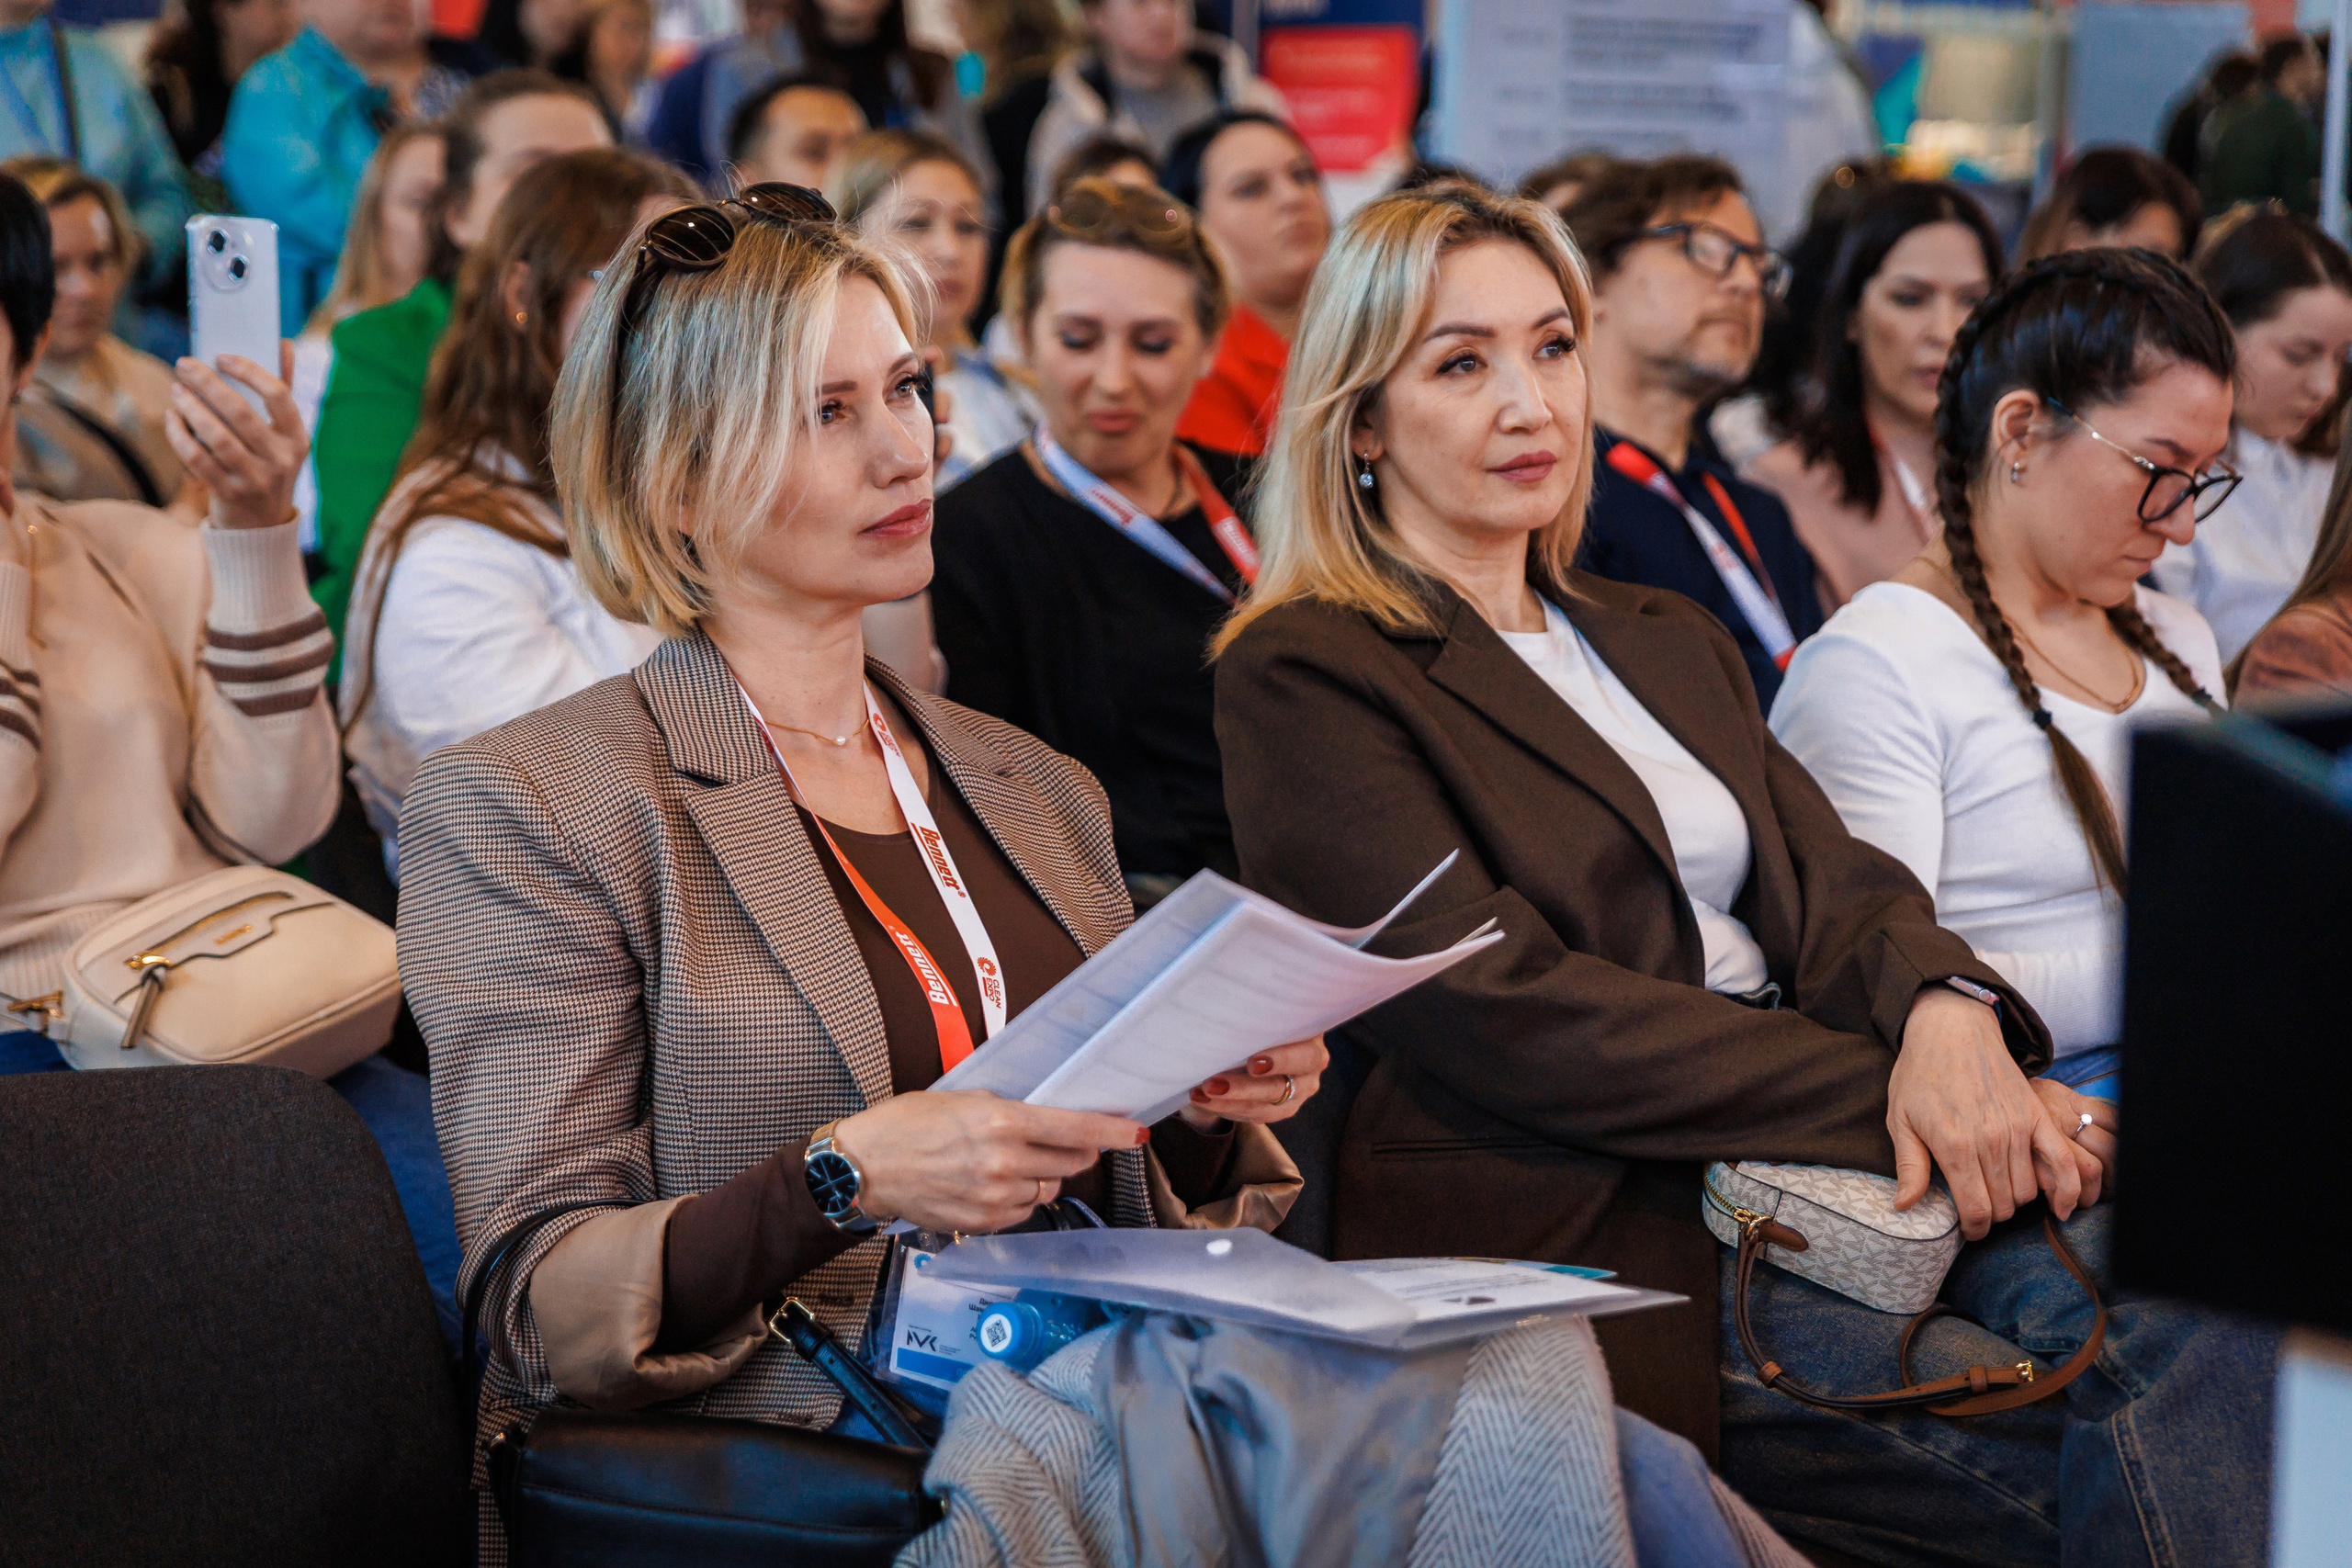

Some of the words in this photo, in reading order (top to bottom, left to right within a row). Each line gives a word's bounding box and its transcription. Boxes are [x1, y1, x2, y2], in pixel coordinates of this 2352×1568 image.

[919, 826, 960, 890] Bennett
[895, 931, 950, 1005] Bennett
[986, 976, 995, 1002] EXPO
[993, 978, 1001, 1009] CLEAN
